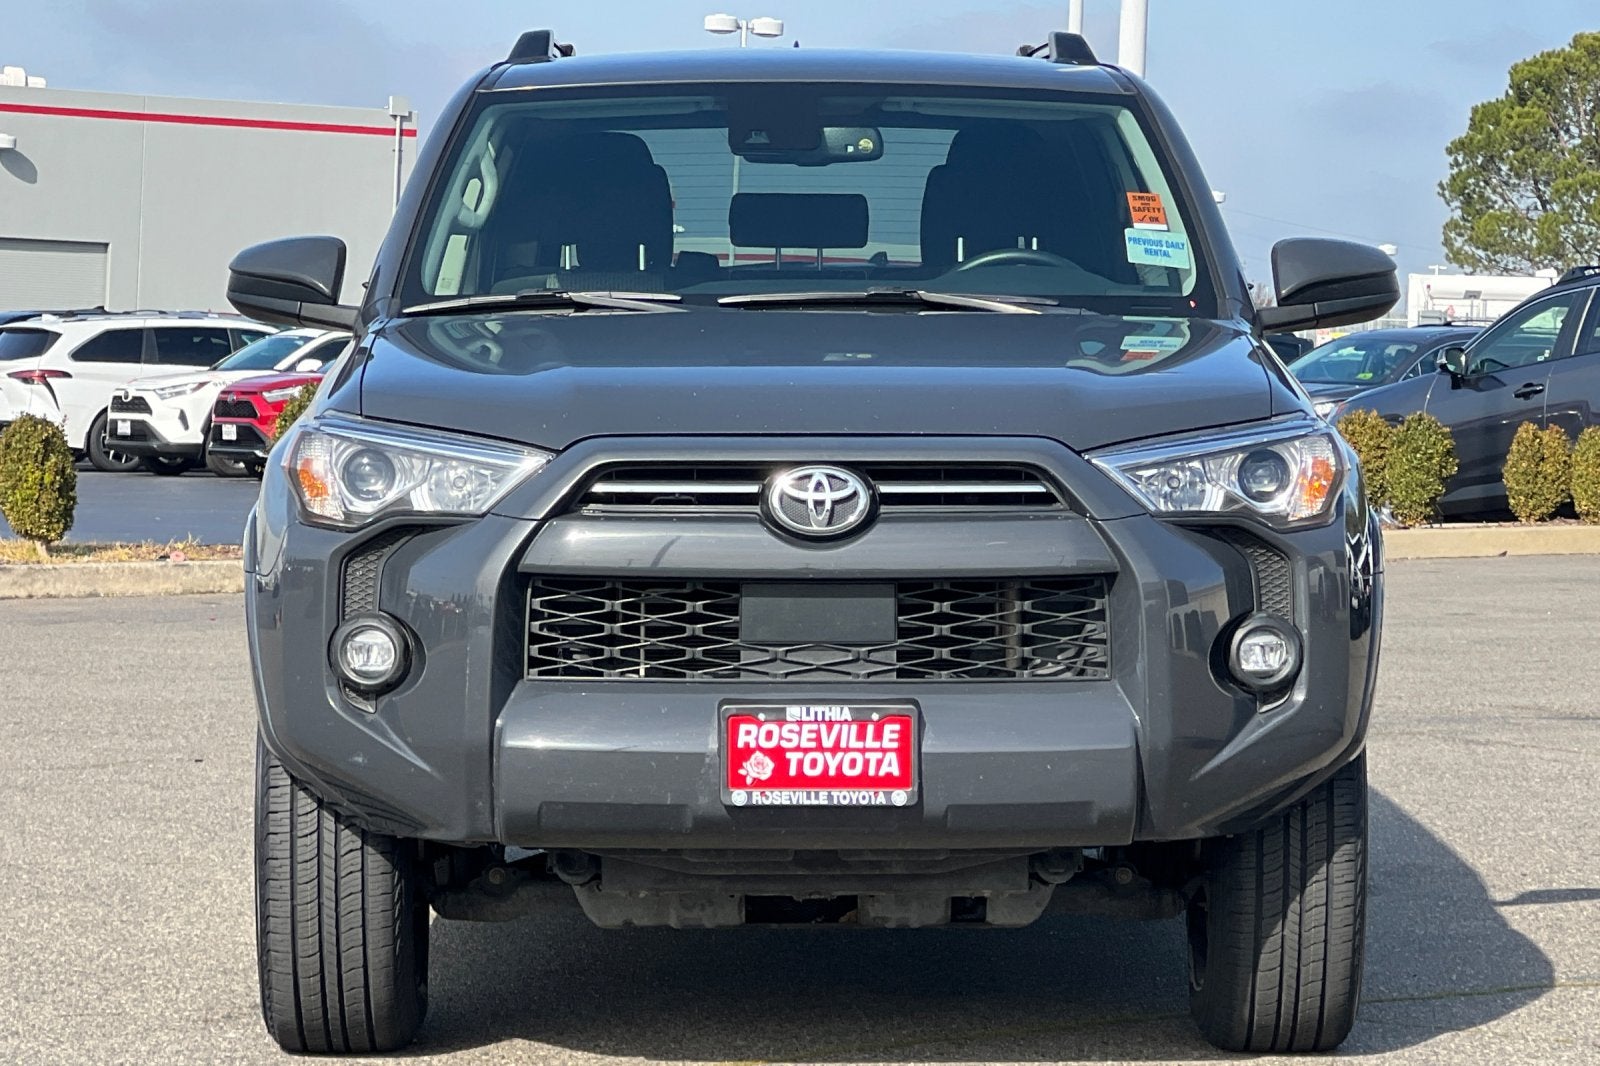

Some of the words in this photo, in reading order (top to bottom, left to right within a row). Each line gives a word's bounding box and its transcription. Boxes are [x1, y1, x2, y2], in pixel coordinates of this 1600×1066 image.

[1127, 236, 1164, 247] PREVIOUS
[1165, 240, 1185, 250] DAILY
[1144, 248, 1172, 257] RENTAL
[802, 706, 852, 721] LITHIA
[737, 723, 901, 748] ROSEVILLE
[785, 751, 900, 777] TOYOTA
[752, 791, 828, 805] ROSEVILLE
[830, 791, 886, 805] TOYOTA
